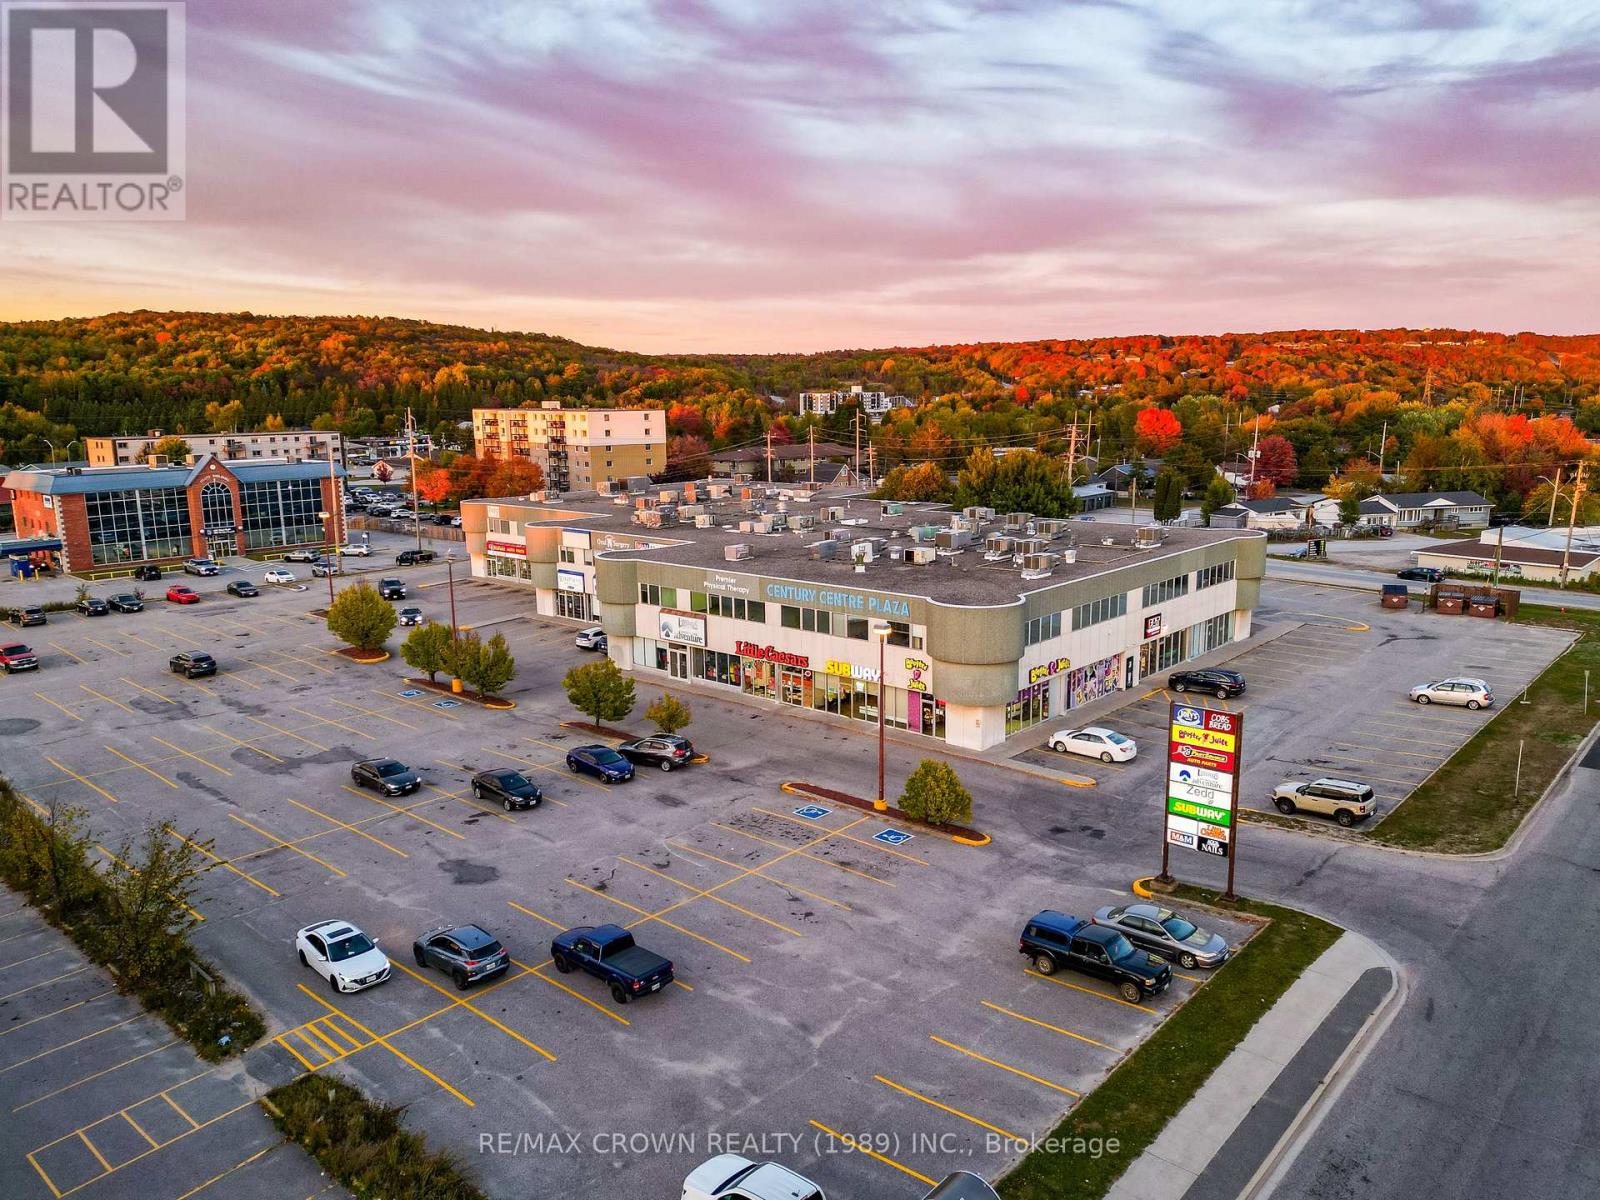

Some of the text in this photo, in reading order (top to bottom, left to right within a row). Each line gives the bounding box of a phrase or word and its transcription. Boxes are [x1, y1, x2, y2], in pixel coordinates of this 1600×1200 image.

[715, 574, 737, 584] Premier
[703, 581, 750, 595] Physical Therapy
[766, 584, 911, 617] CENTURY CENTRE PLAZA
[735, 640, 809, 668] Little Caesars
[825, 659, 881, 682] SUBWAY
[1208, 720, 1232, 731] BREAD
[1210, 713, 1230, 724] COBS
[1186, 784, 1215, 799] Zedd
[1174, 802, 1226, 820] SUBWAY
[1201, 843, 1224, 856] NAILS
